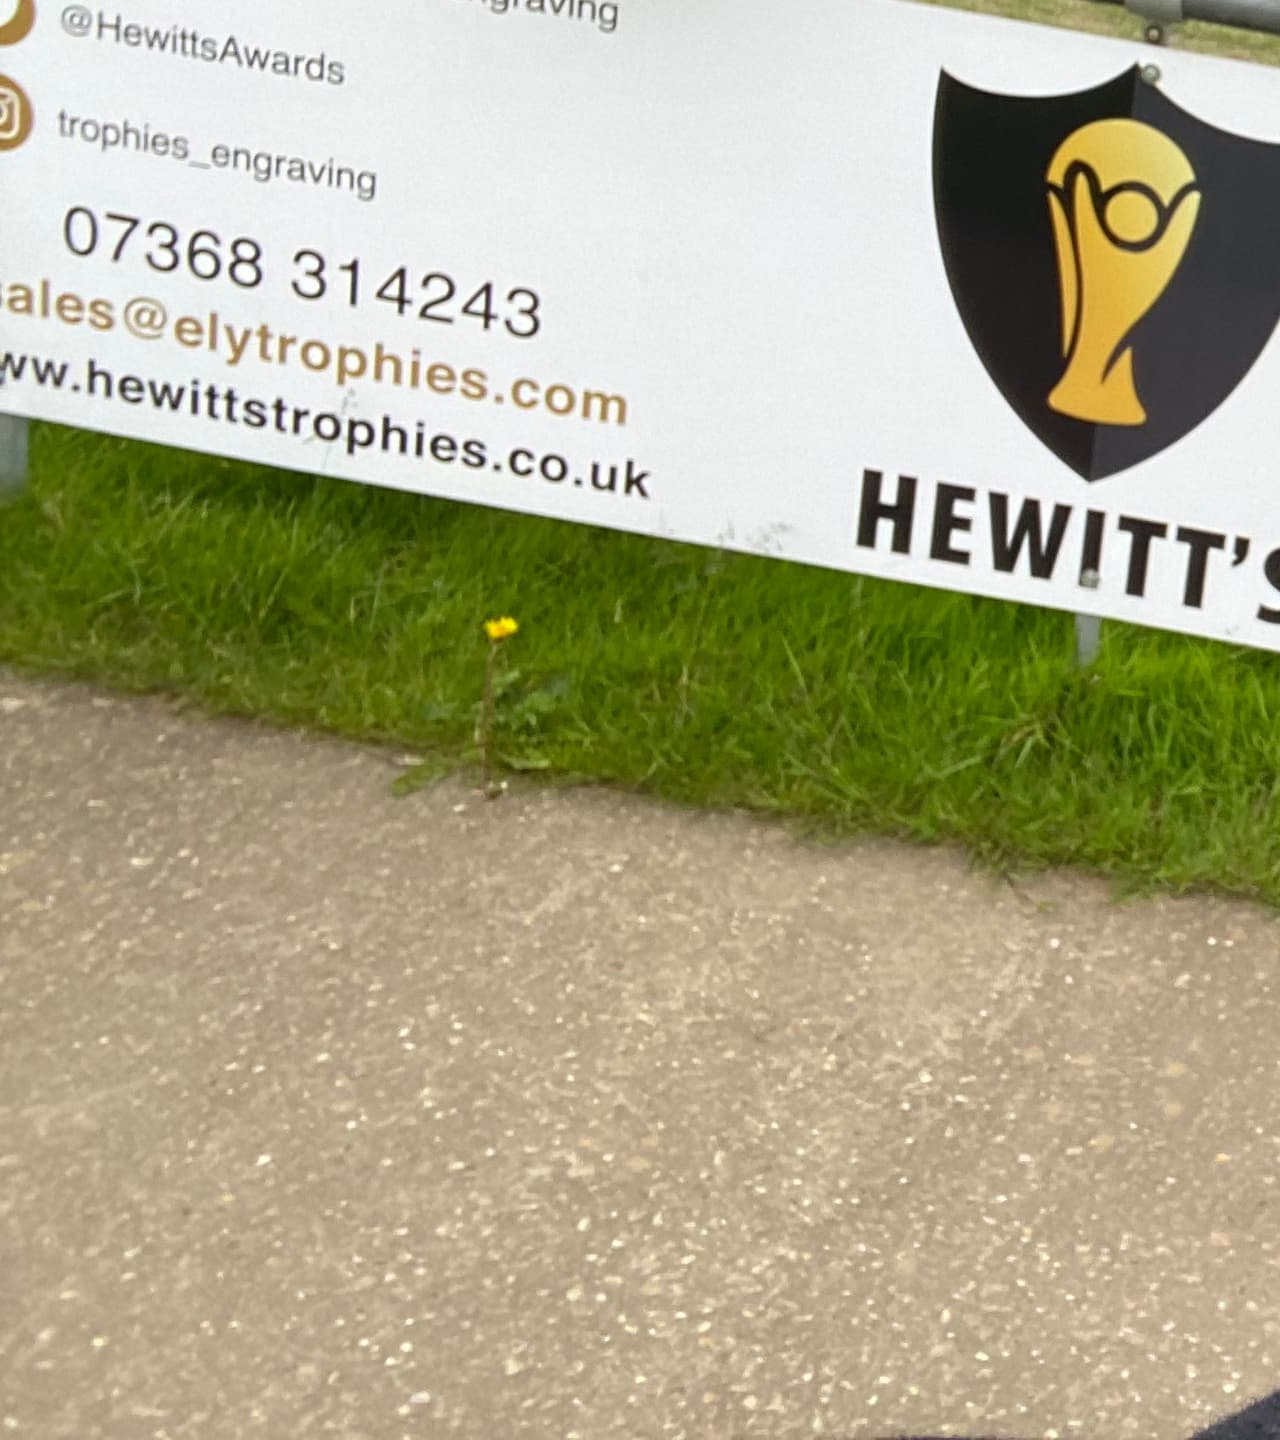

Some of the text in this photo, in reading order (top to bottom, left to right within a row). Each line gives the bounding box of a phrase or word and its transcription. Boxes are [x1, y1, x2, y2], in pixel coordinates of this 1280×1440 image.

[61, 5, 345, 85] @HewittsAwards
[58, 109, 377, 202] trophies_engraving
[63, 206, 541, 339] 07368 314243
[0, 278, 627, 426] ales@elytrophies.com
